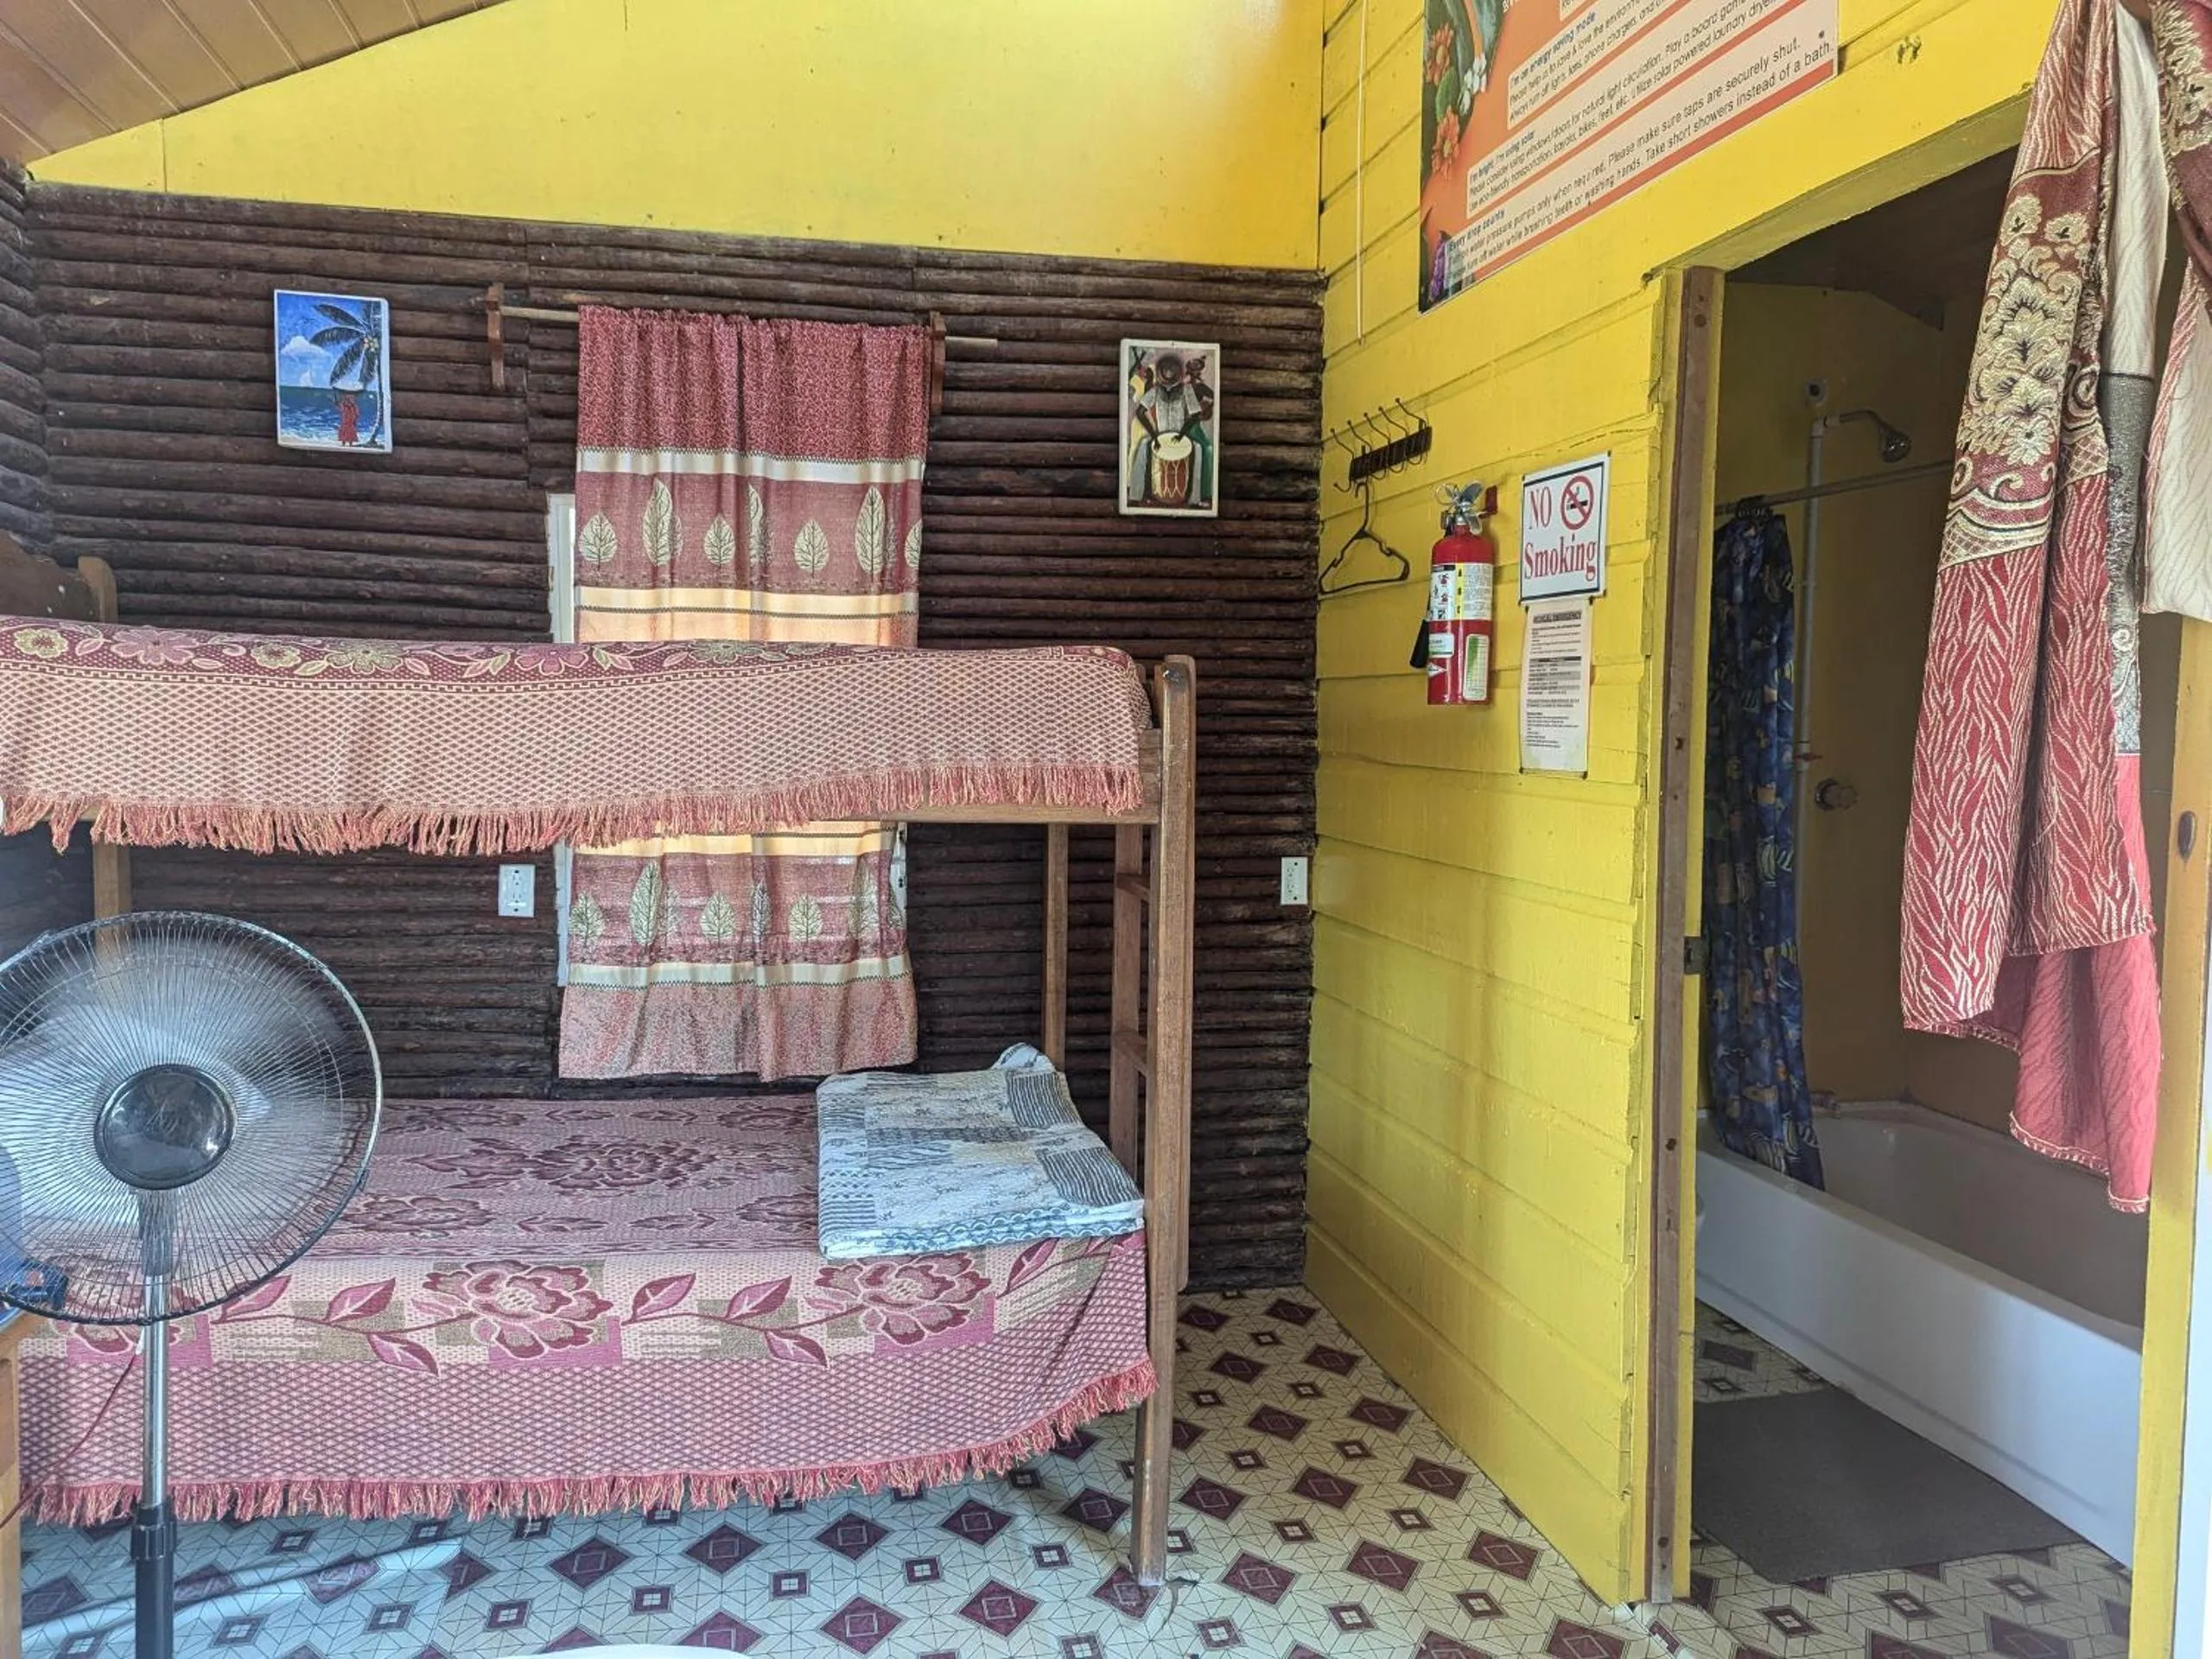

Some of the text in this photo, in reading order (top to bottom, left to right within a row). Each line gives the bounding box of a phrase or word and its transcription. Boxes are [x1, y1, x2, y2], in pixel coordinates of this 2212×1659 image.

[1553, 29, 1574, 52] saving
[1576, 11, 1596, 33] mode
[1607, 79, 1621, 99] light
[1666, 40, 1681, 58] Play
[1692, 13, 1718, 35] board
[1654, 62, 1672, 83] solar
[1673, 36, 1712, 73] powered
[1713, 13, 1747, 42] laundry
[1506, 230, 1522, 246] while
[1524, 213, 1554, 236] brushing
[1555, 199, 1573, 219] teeth
[1574, 193, 1584, 206] or
[1585, 175, 1614, 200] washing
[1617, 156, 1644, 177] hands.
[1644, 142, 1665, 162] Take
[1668, 124, 1691, 148] short
[1694, 100, 1733, 132] showers
[1737, 74, 1775, 106] instead
[1779, 64, 1791, 81] of
[1793, 60, 1801, 73] a
[1804, 41, 1834, 66] bath.
[1514, 207, 1535, 227] pumps
[1536, 195, 1552, 213] only
[1554, 183, 1573, 201] when
[1608, 142, 1635, 166] Please
[1637, 125, 1659, 147] make
[1662, 111, 1681, 132] sure
[1683, 98, 1705, 118] taps
[1707, 86, 1723, 105] are
[1725, 54, 1769, 92] securely
[1773, 36, 1801, 63] shut.
[1449, 209, 1505, 251] Every drop counts
[1529, 486, 1552, 530] NO
[1524, 532, 1596, 582] Smoking
